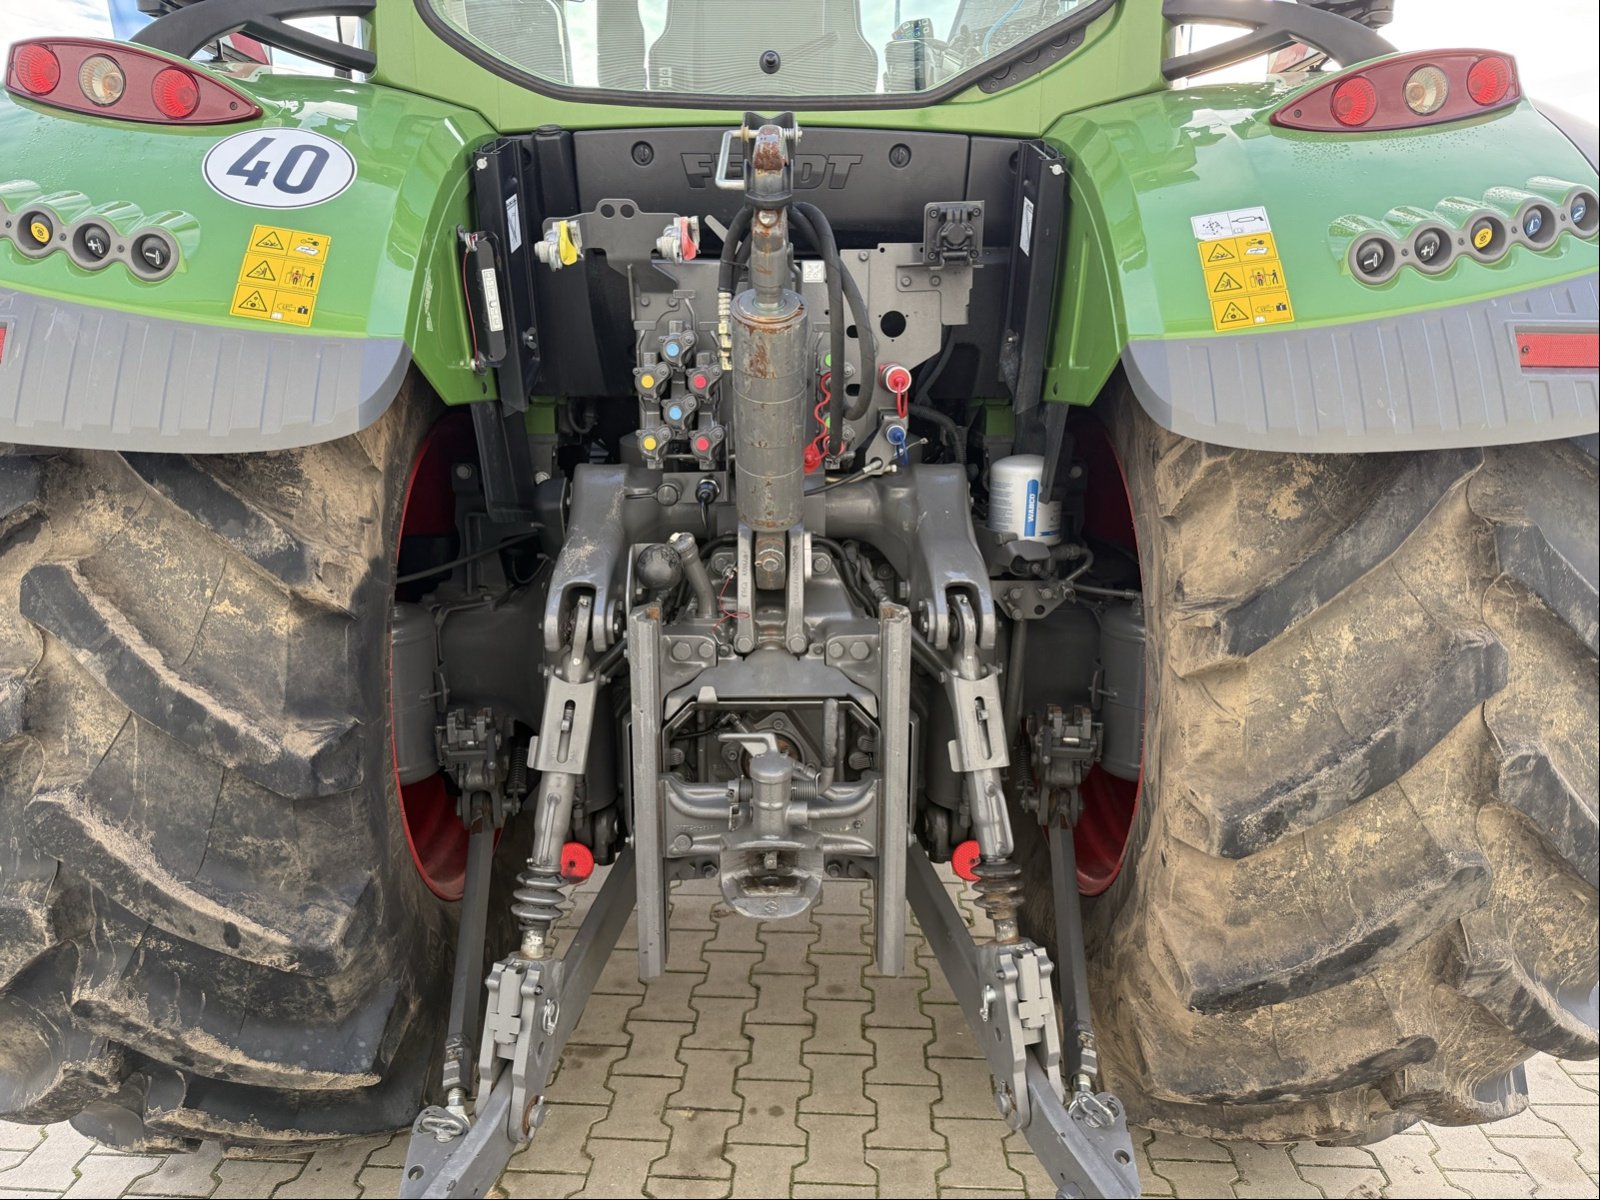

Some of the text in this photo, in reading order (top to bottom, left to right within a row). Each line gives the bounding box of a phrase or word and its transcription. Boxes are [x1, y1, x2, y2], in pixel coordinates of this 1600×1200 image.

[226, 136, 330, 195] 40
[680, 153, 863, 190] FEDT
[1027, 493, 1036, 523] WABCO
